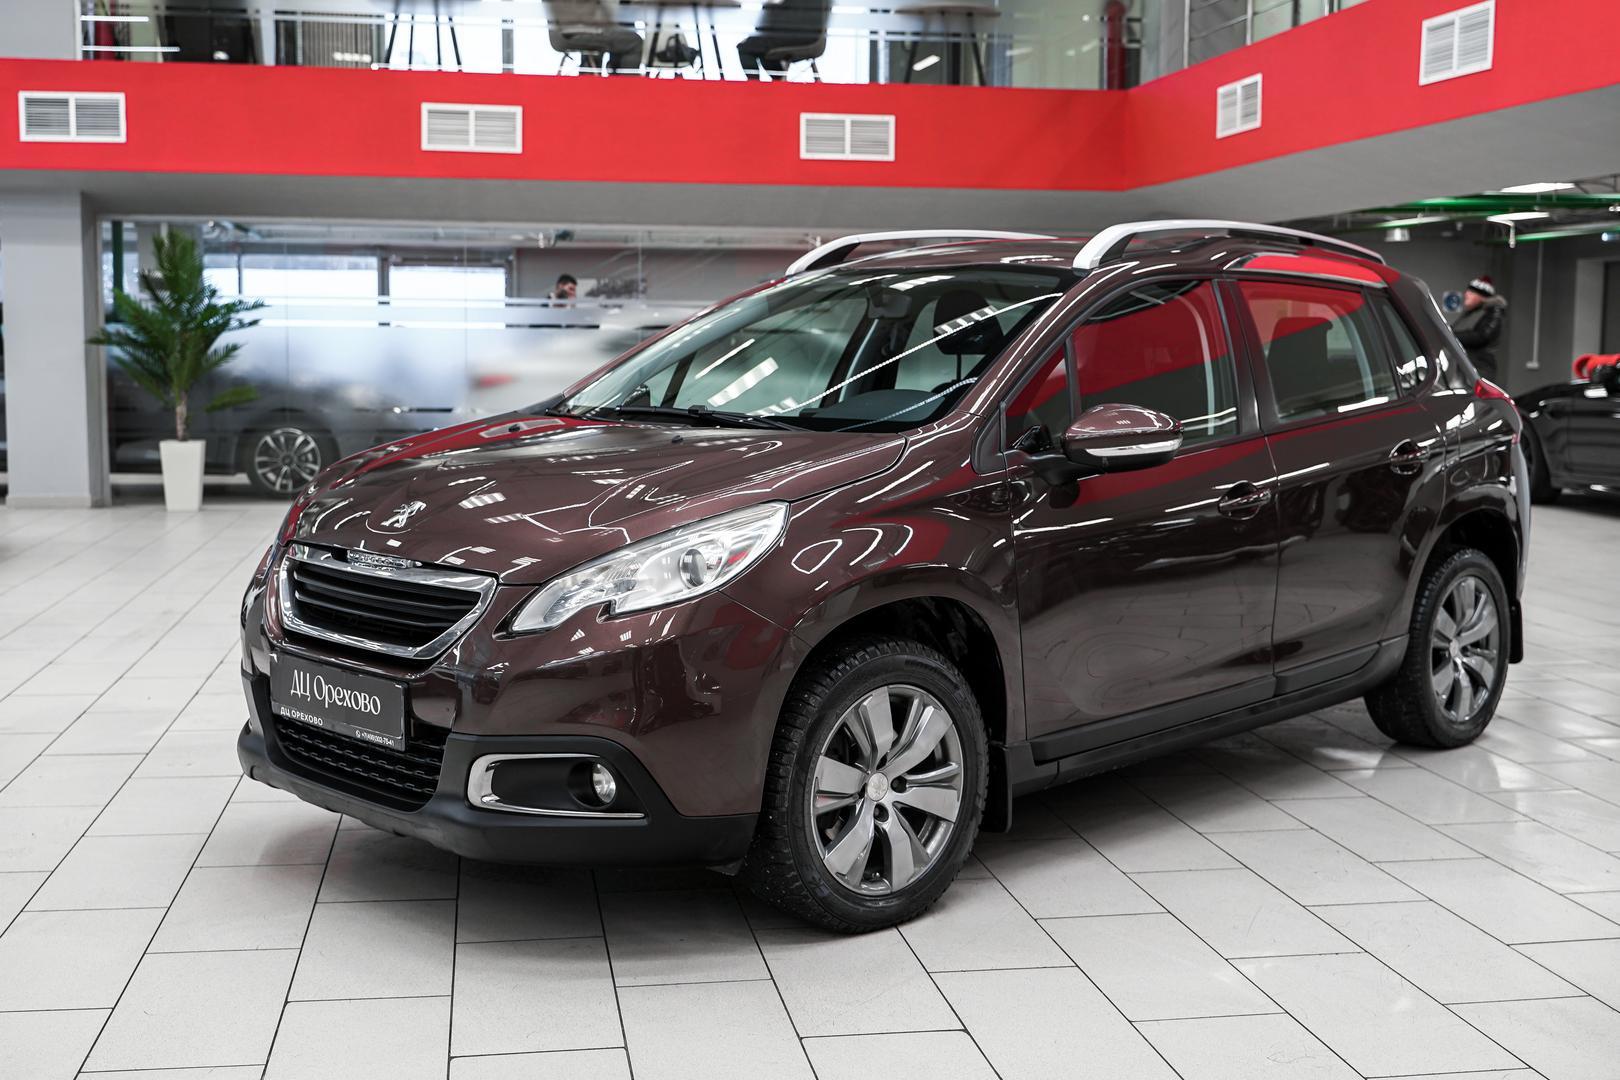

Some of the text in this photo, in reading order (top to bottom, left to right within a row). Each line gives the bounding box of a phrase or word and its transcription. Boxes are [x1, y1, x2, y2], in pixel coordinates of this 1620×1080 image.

[290, 669, 381, 715] ДЦ Орехово
[280, 706, 324, 726] ДЦ ОРЕХОВО
